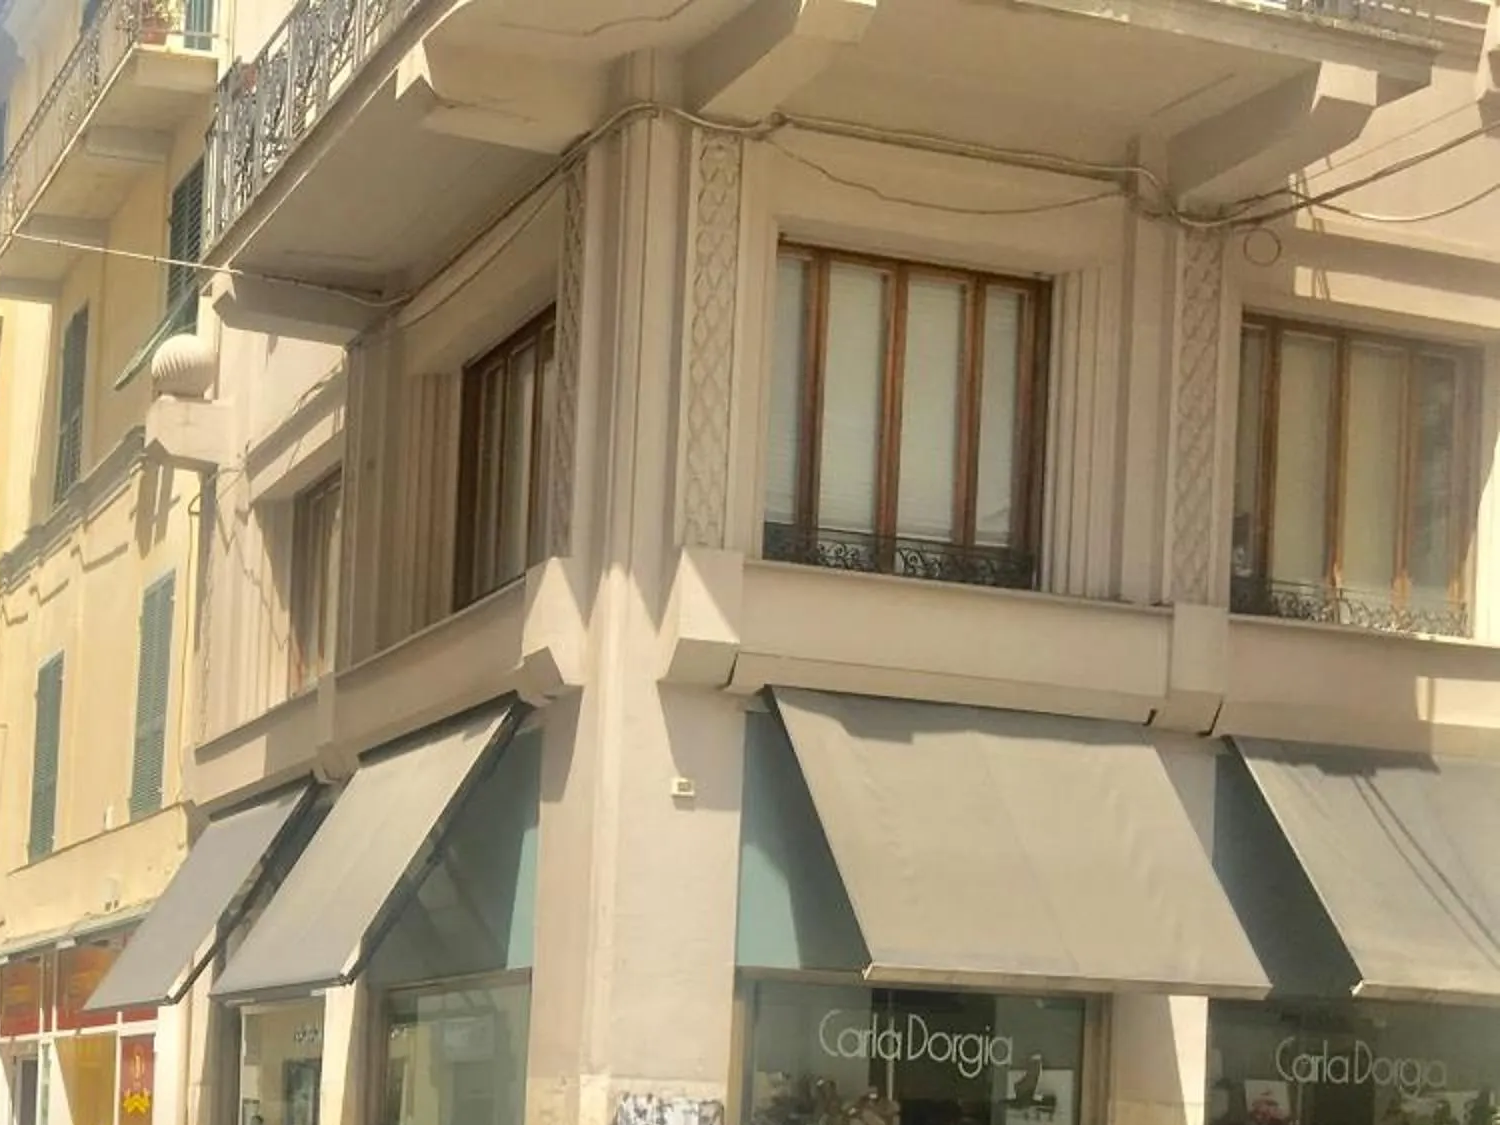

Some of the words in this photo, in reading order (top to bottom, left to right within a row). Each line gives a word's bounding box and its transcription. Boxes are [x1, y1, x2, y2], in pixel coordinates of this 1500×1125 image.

[819, 1009, 903, 1060] Carla
[907, 1013, 1013, 1078] Dorgia
[1276, 1036, 1349, 1084] Carla
